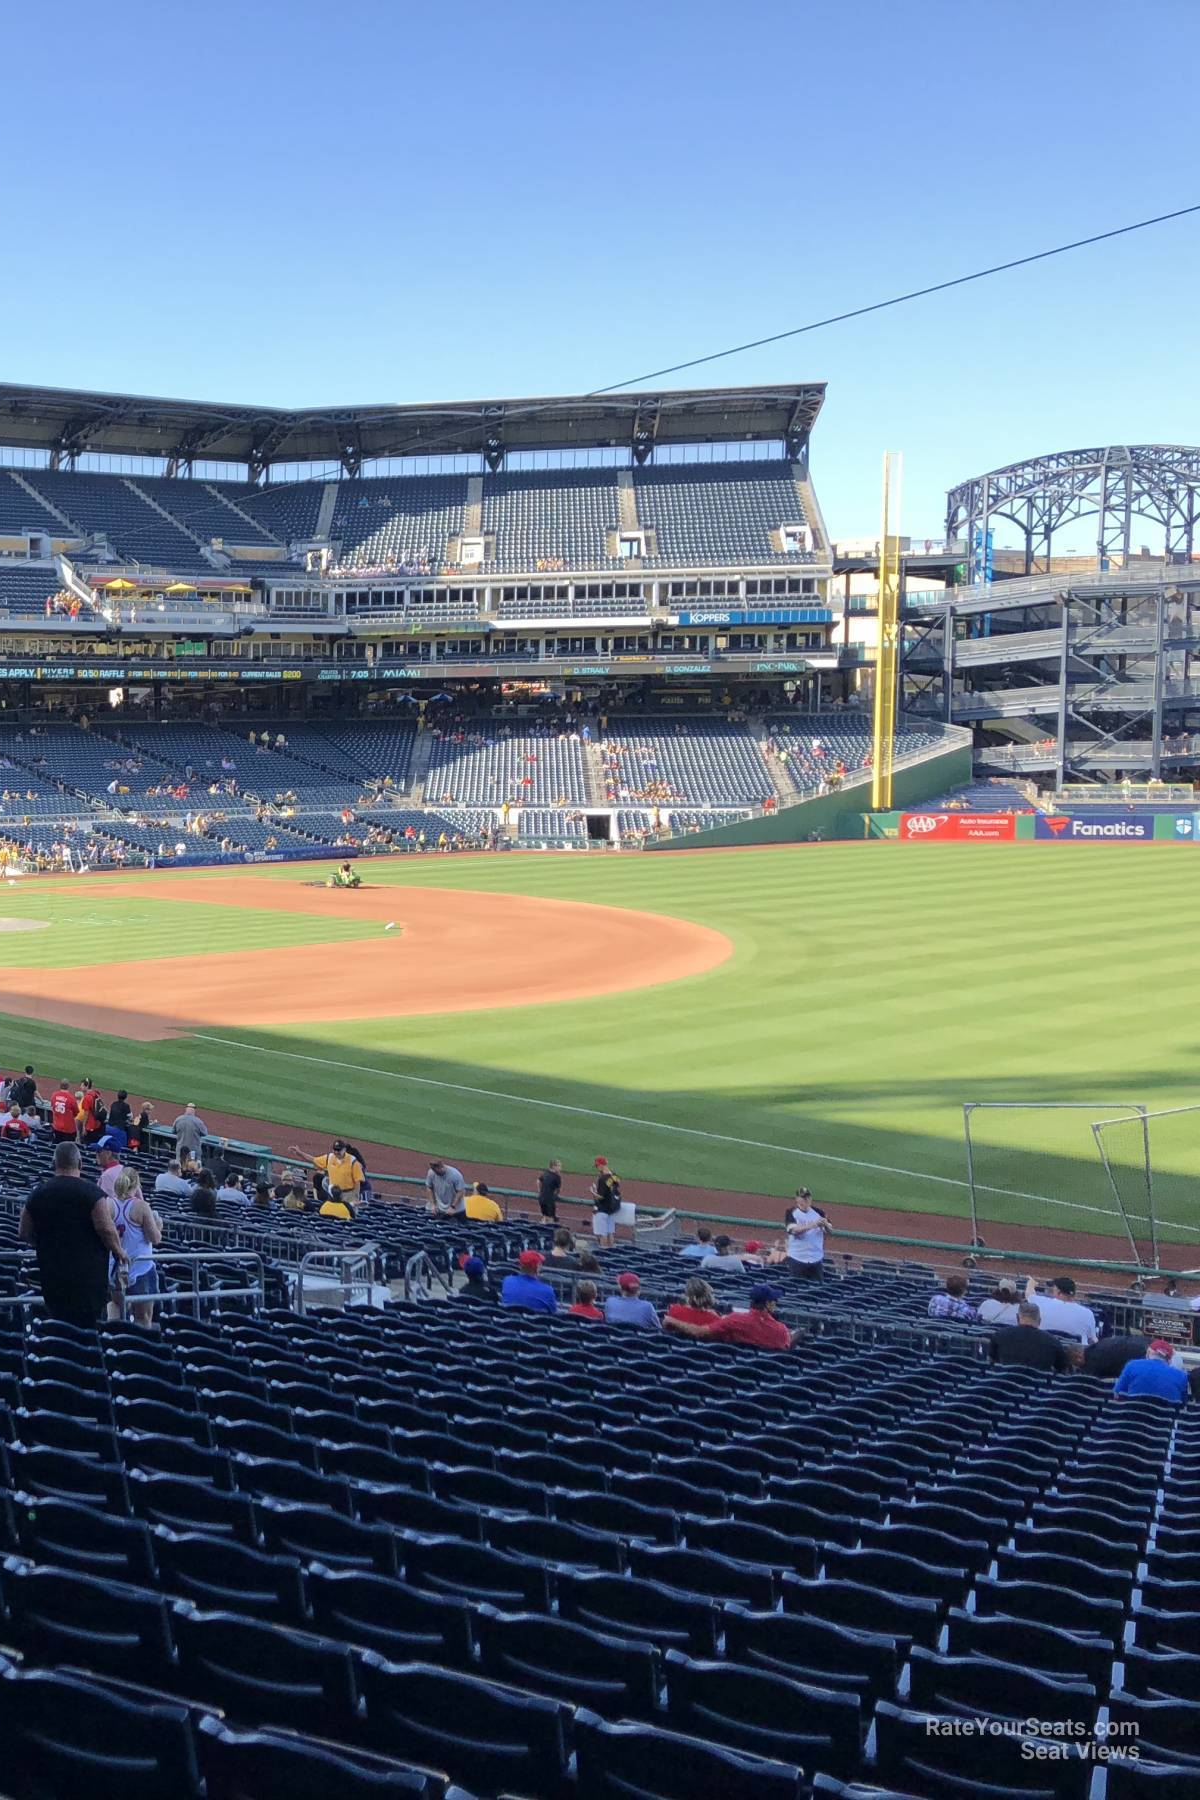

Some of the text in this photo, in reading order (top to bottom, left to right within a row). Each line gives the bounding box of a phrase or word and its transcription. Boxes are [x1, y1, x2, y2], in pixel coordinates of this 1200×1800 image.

[689, 610, 730, 624] KOPPERS
[8, 668, 36, 678] APPLY.
[100, 670, 124, 678] RAFFLE
[283, 670, 301, 679] $200
[383, 669, 420, 678] MIAMI
[1072, 821, 1144, 836] Fanatics
[1152, 1318, 1184, 1327] CAUTION
